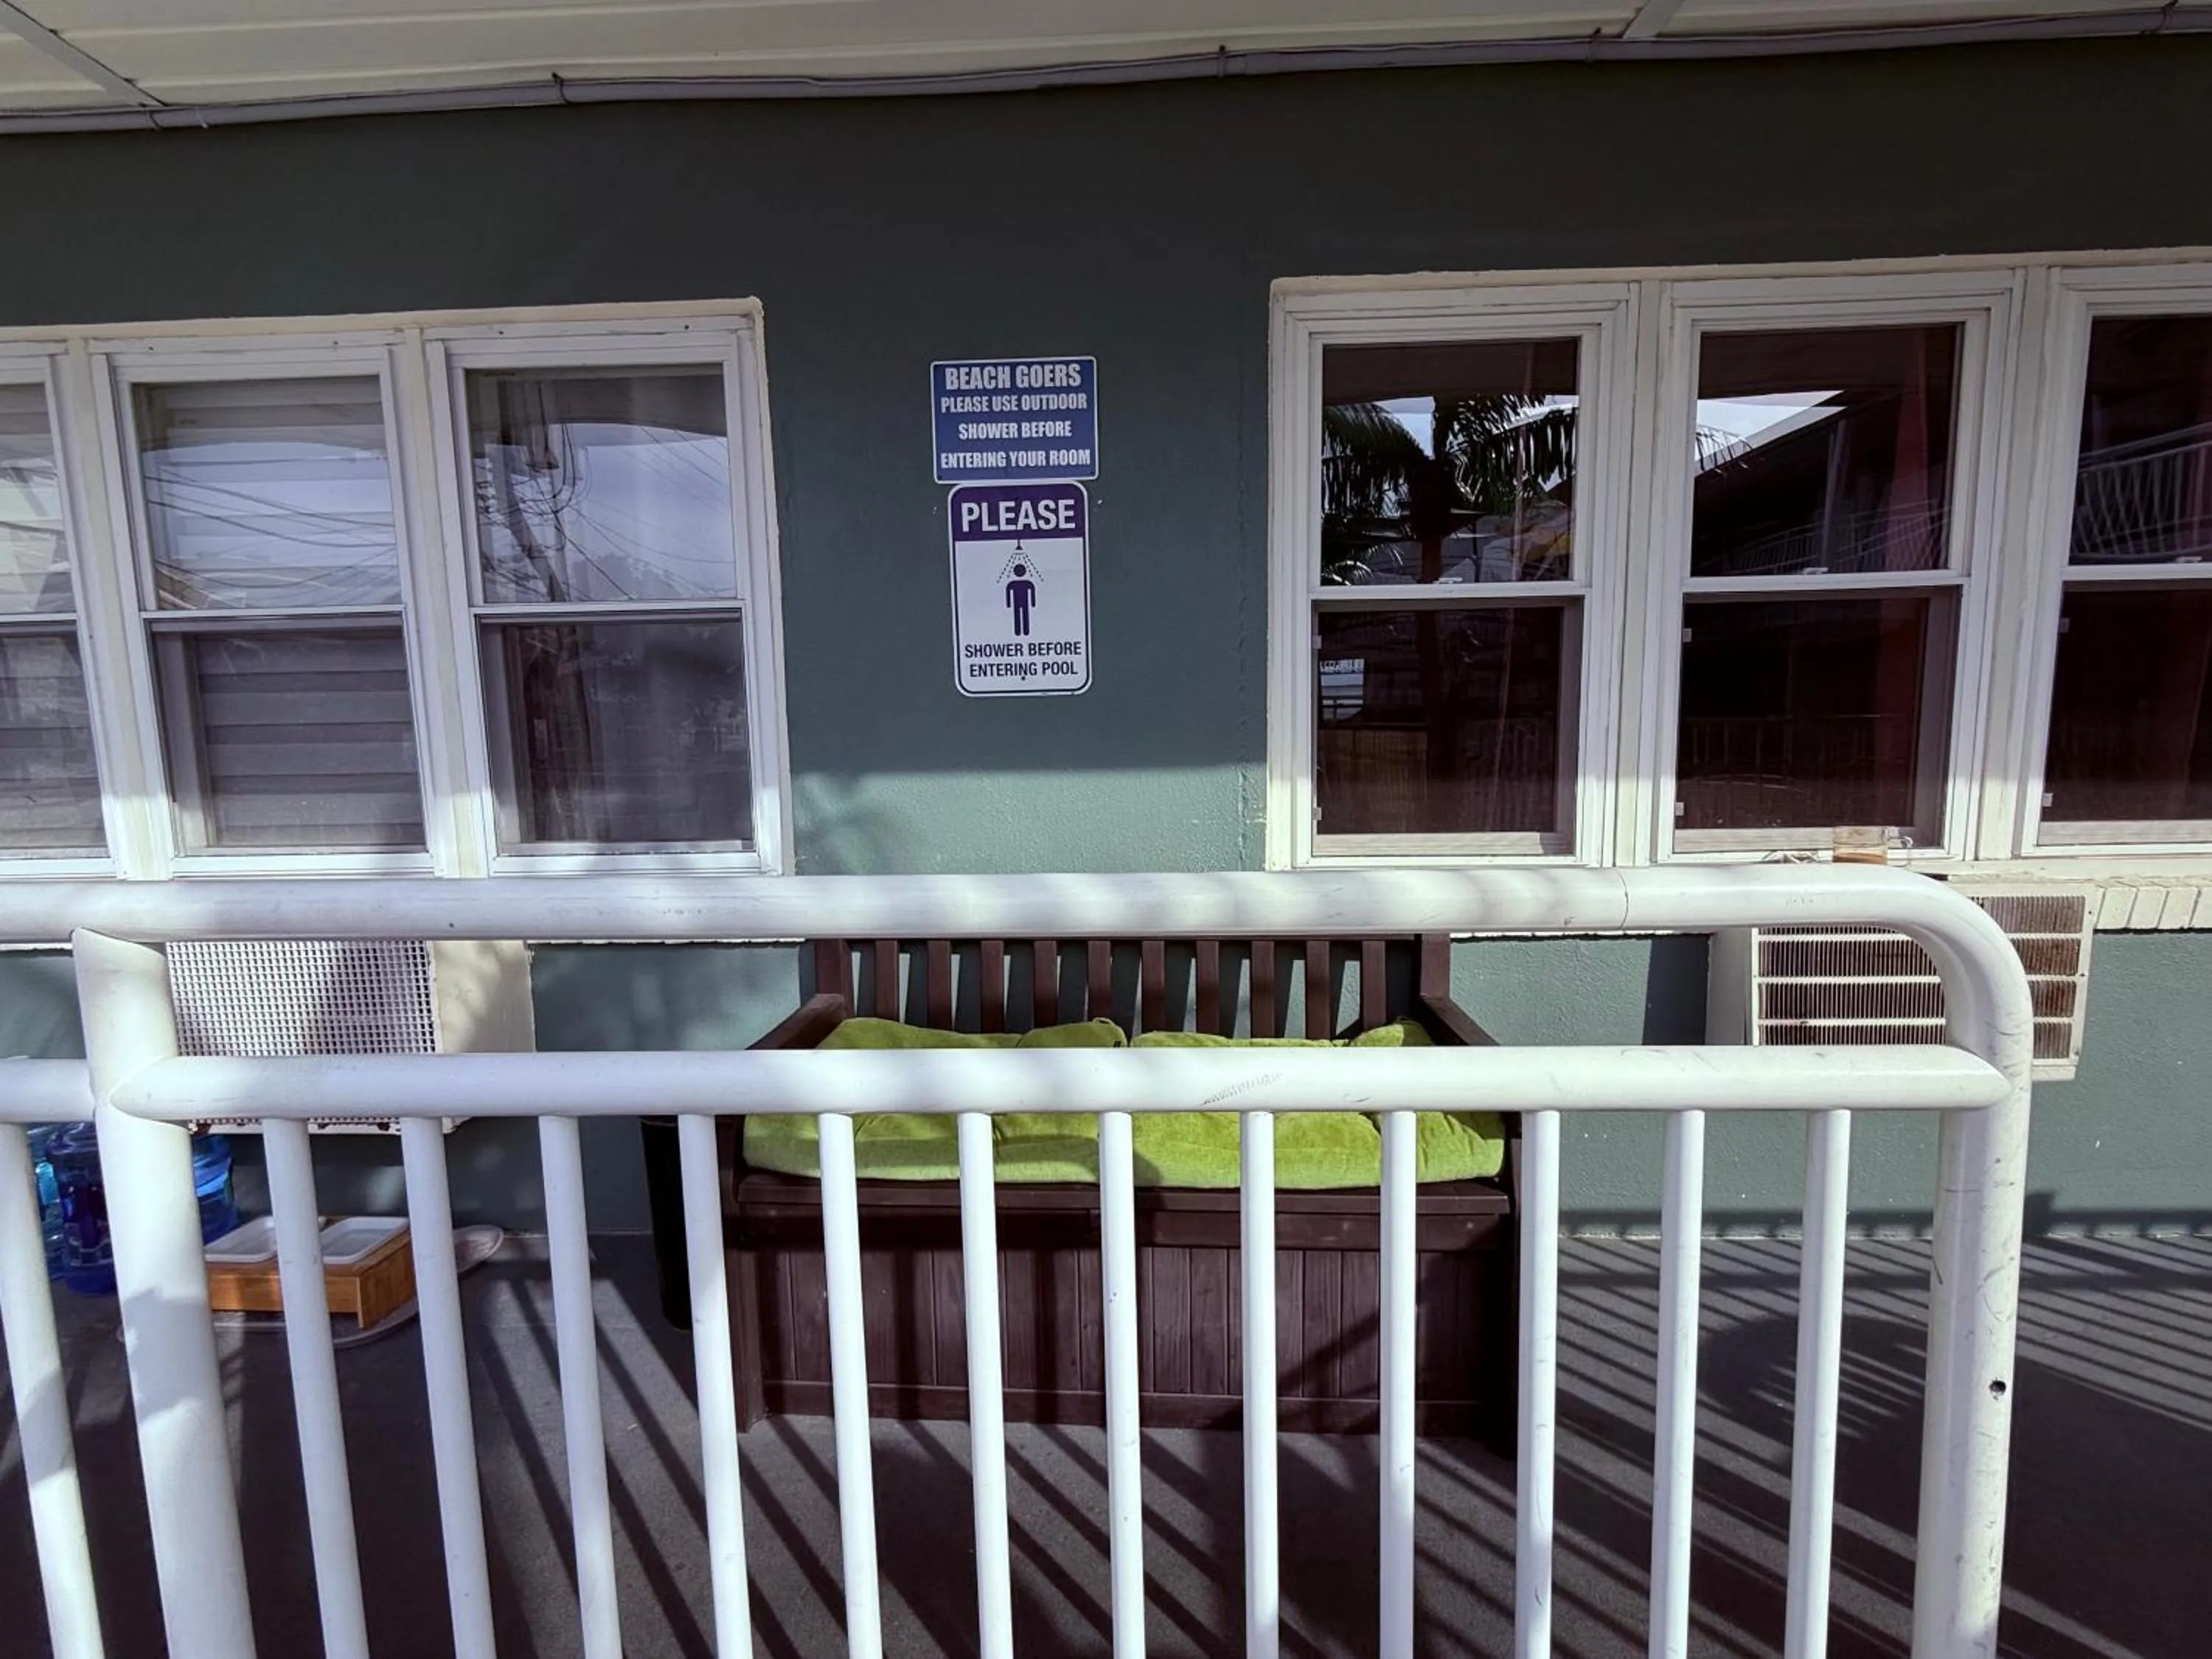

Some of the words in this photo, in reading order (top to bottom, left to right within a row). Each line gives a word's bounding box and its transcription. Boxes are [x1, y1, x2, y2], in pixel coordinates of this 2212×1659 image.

[945, 366, 1011, 390] BEACH
[1015, 364, 1082, 388] GOERS
[941, 396, 989, 413] PLEASE
[992, 394, 1018, 411] USE
[1021, 393, 1088, 411] OUTDOOR
[959, 422, 1018, 440] SHOWER
[1021, 420, 1072, 438] BEFORE
[941, 452, 1006, 469] ENTERING
[1009, 451, 1046, 467] YOUR
[1049, 449, 1091, 465] ROOM
[961, 499, 1076, 532] PLEASE
[965, 643, 1023, 658] SHOWER
[1029, 641, 1082, 656] BEFORE
[970, 662, 1037, 678] ENTERING
[1042, 661, 1078, 675] POOL
